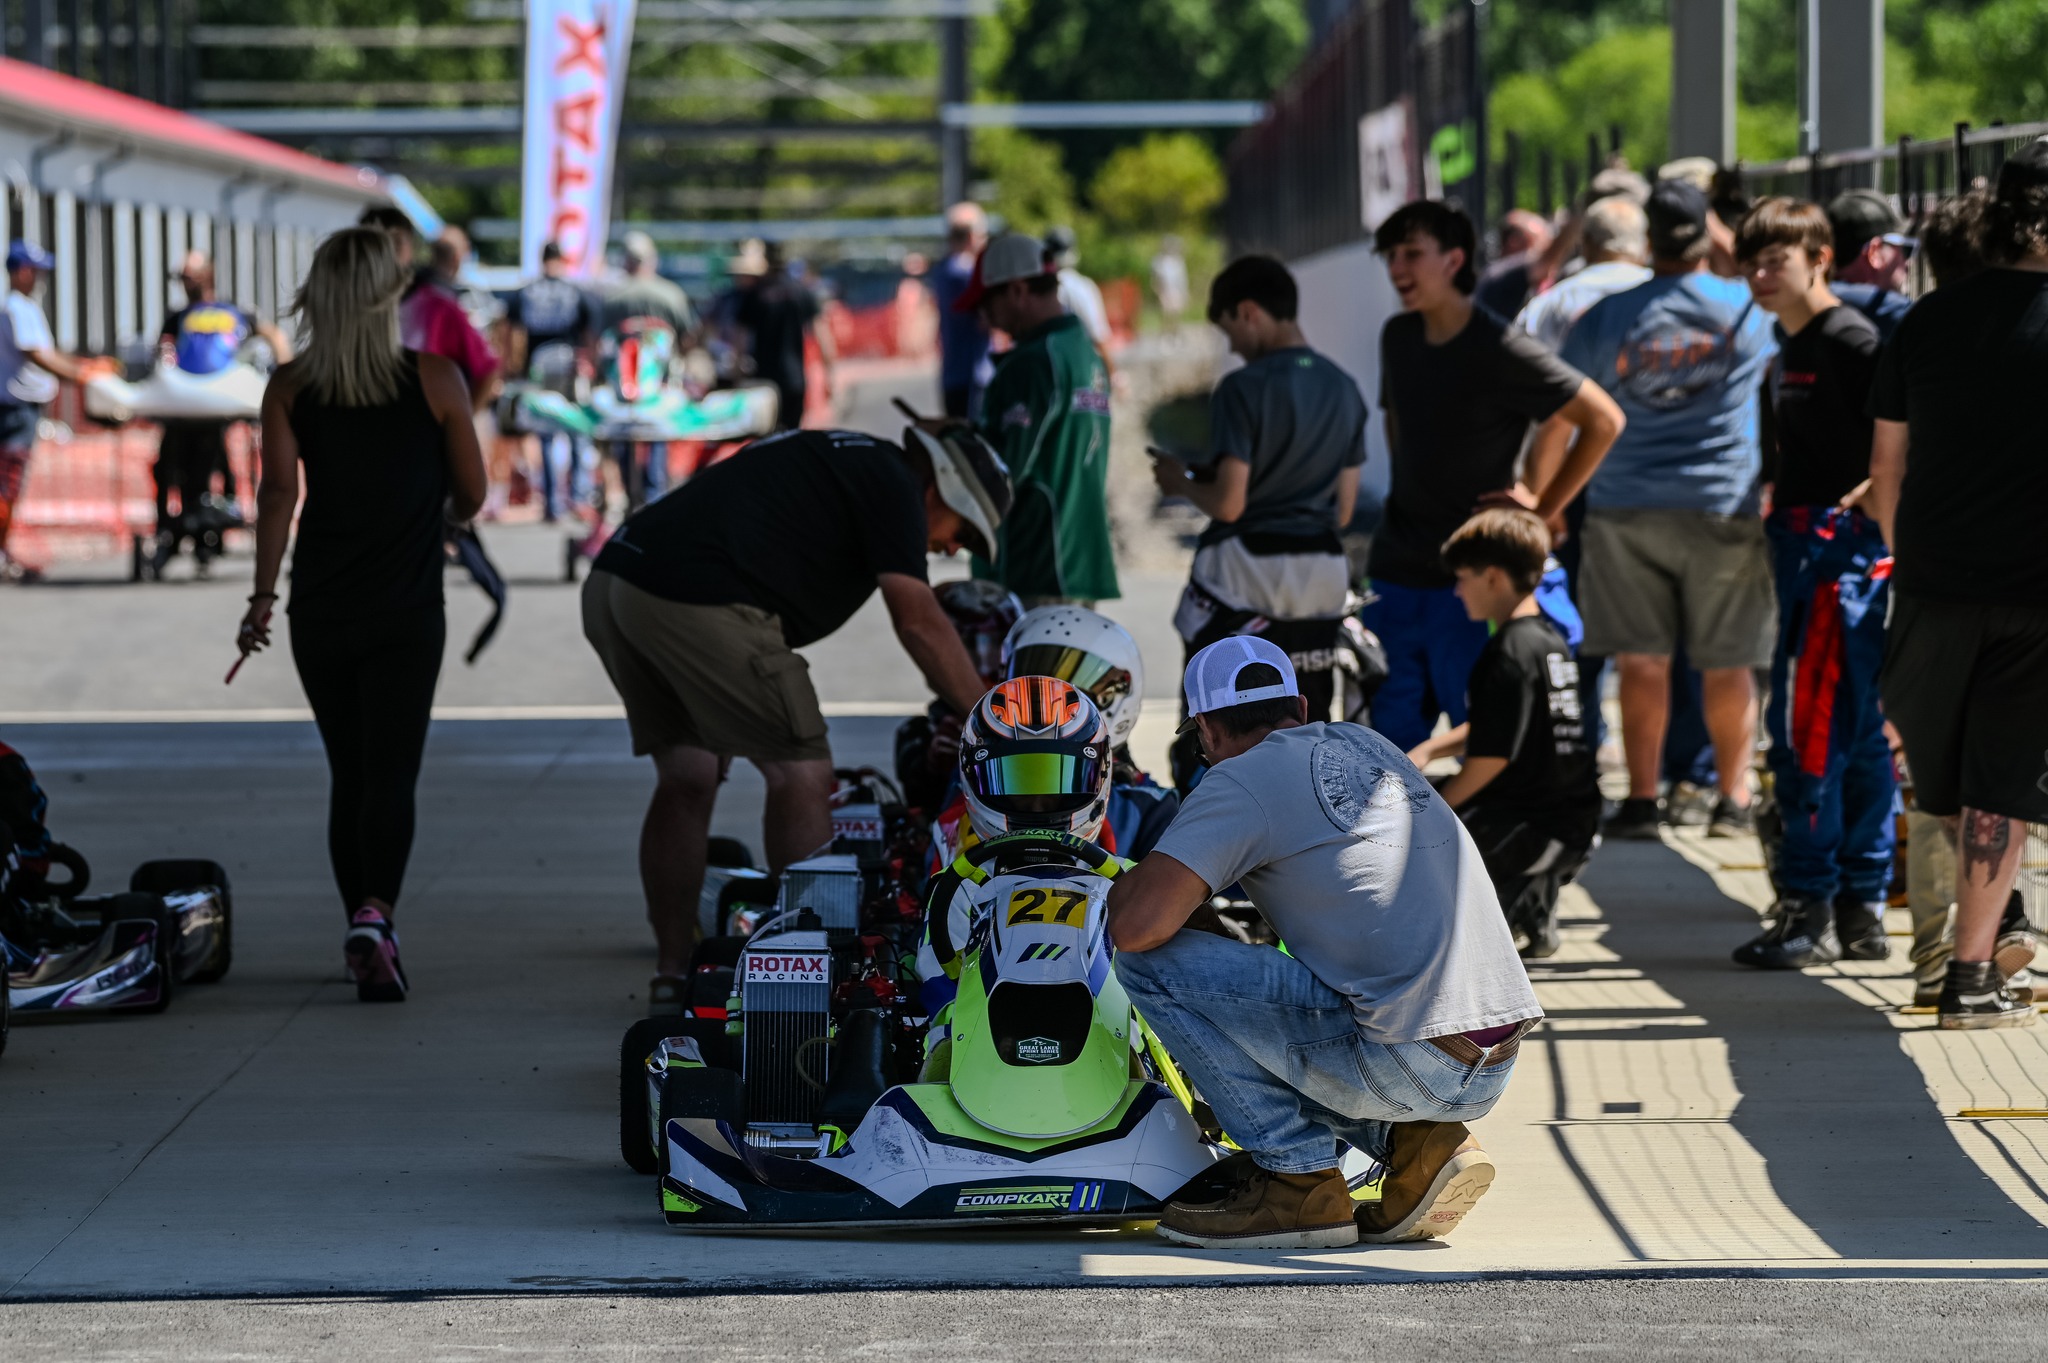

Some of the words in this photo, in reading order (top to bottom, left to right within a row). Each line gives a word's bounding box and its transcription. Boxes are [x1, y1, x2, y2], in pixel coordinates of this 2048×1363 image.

[1008, 889, 1087, 926] 27
[749, 957, 824, 973] ROTAX
[748, 973, 824, 981] RACING
[956, 1194, 1072, 1208] COMPKART
